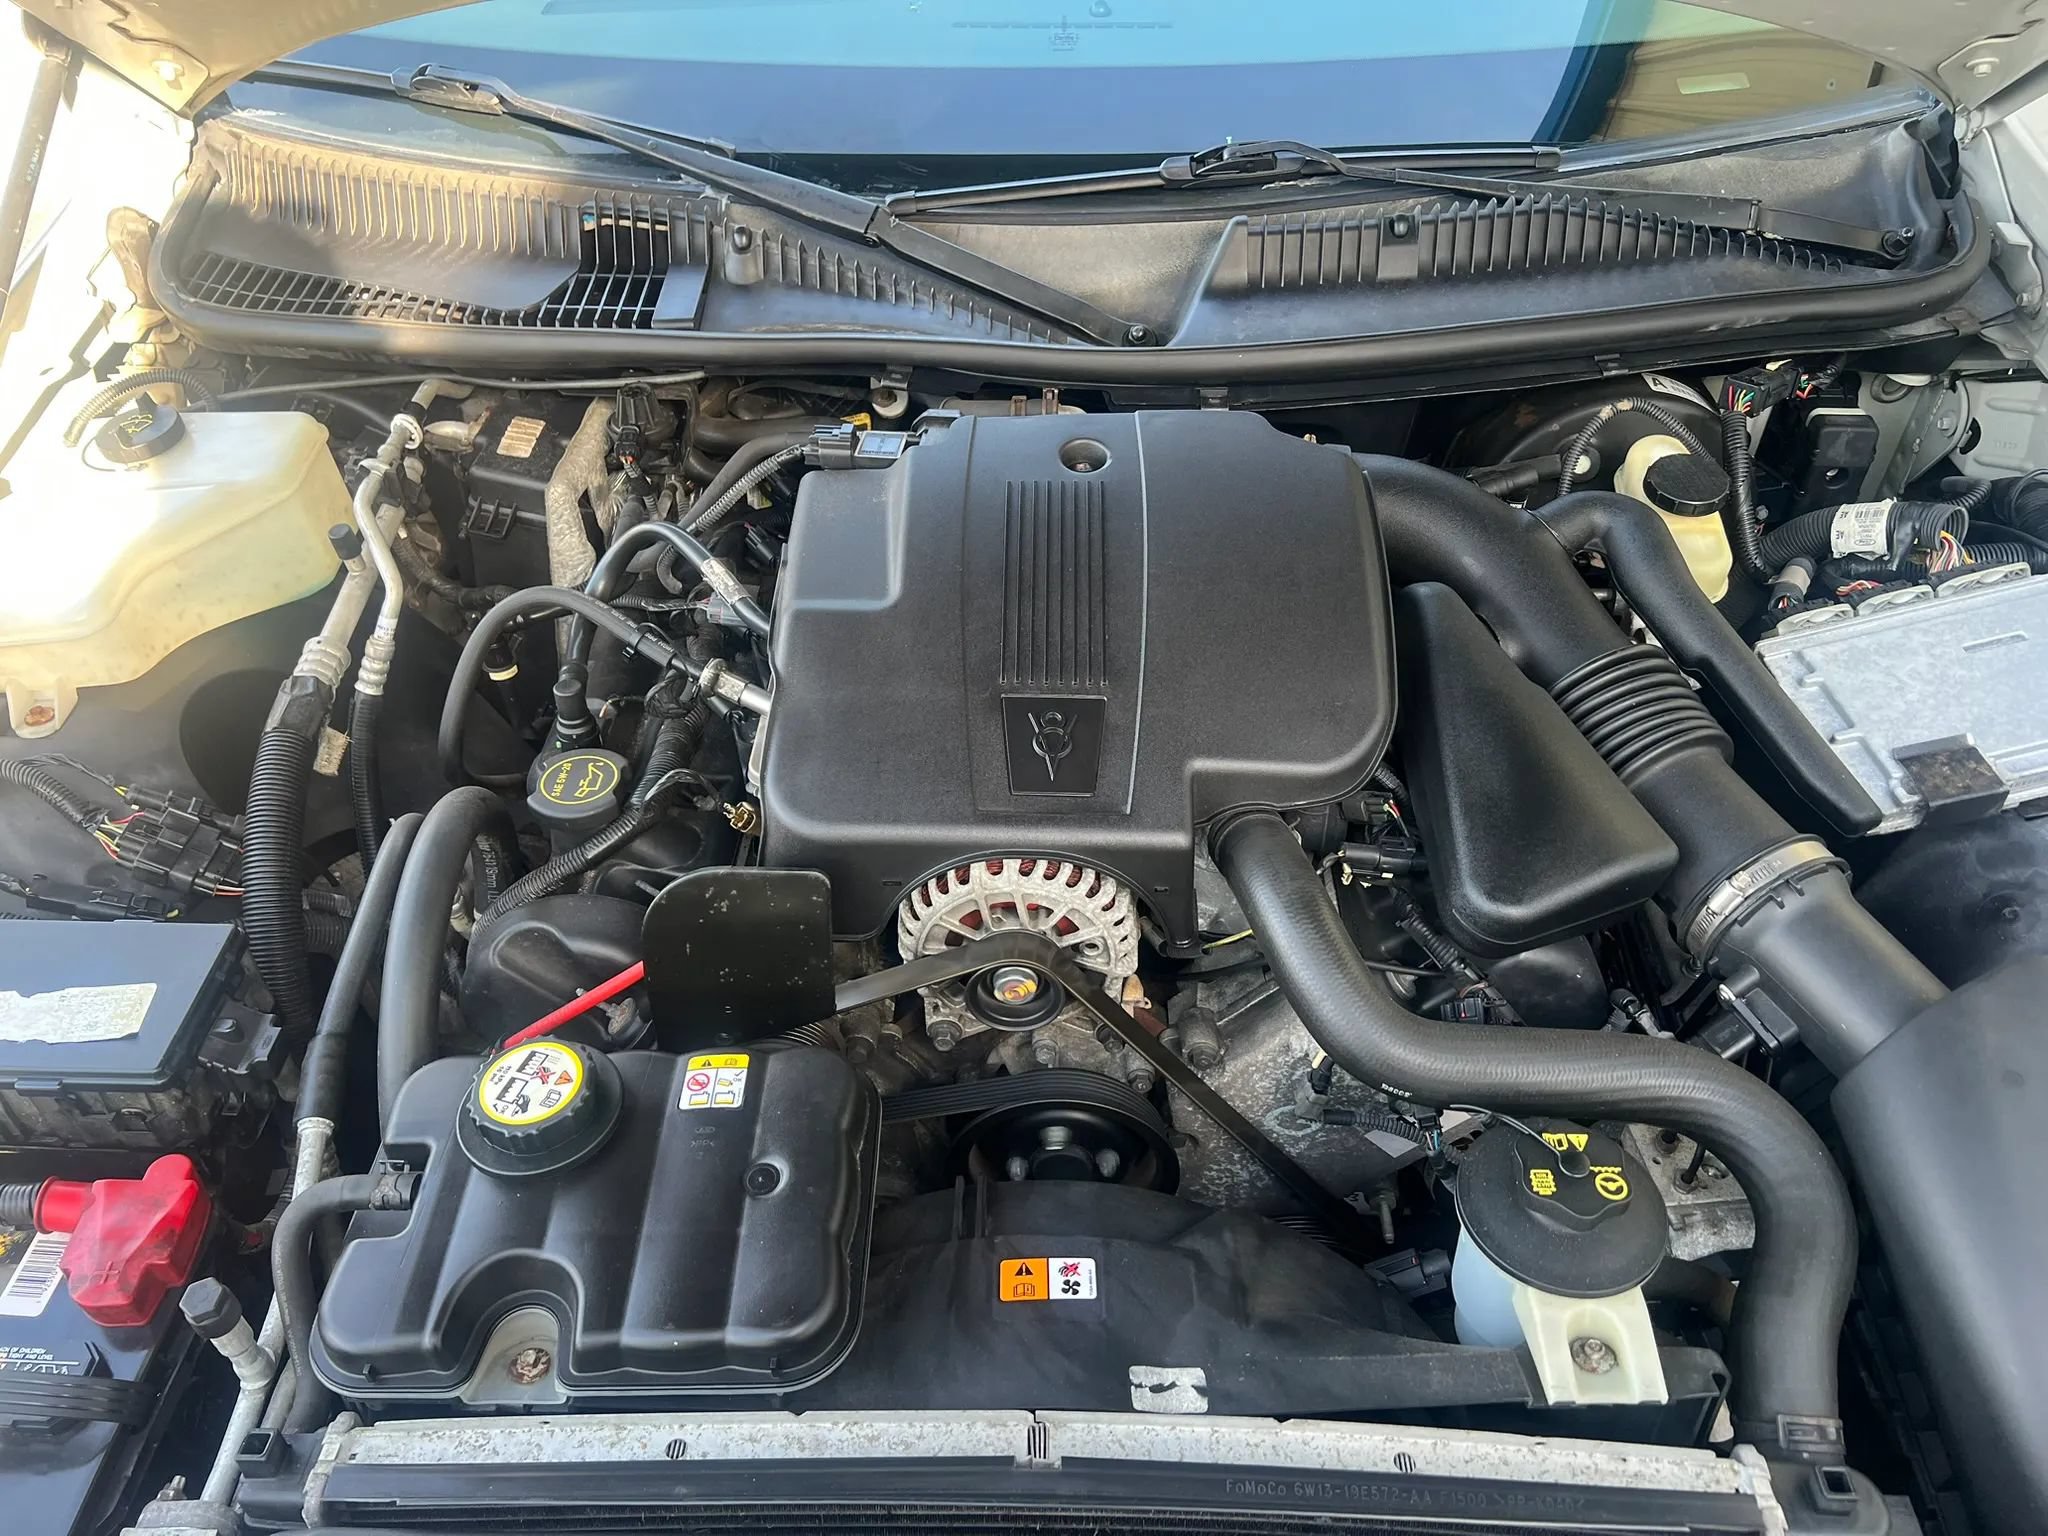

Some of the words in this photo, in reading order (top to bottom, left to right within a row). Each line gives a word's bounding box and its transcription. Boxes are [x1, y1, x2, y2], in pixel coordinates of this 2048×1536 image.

[556, 762, 572, 785] 5W-20
[551, 783, 564, 797] SAE
[1226, 1478, 1287, 1496] FoMoCo
